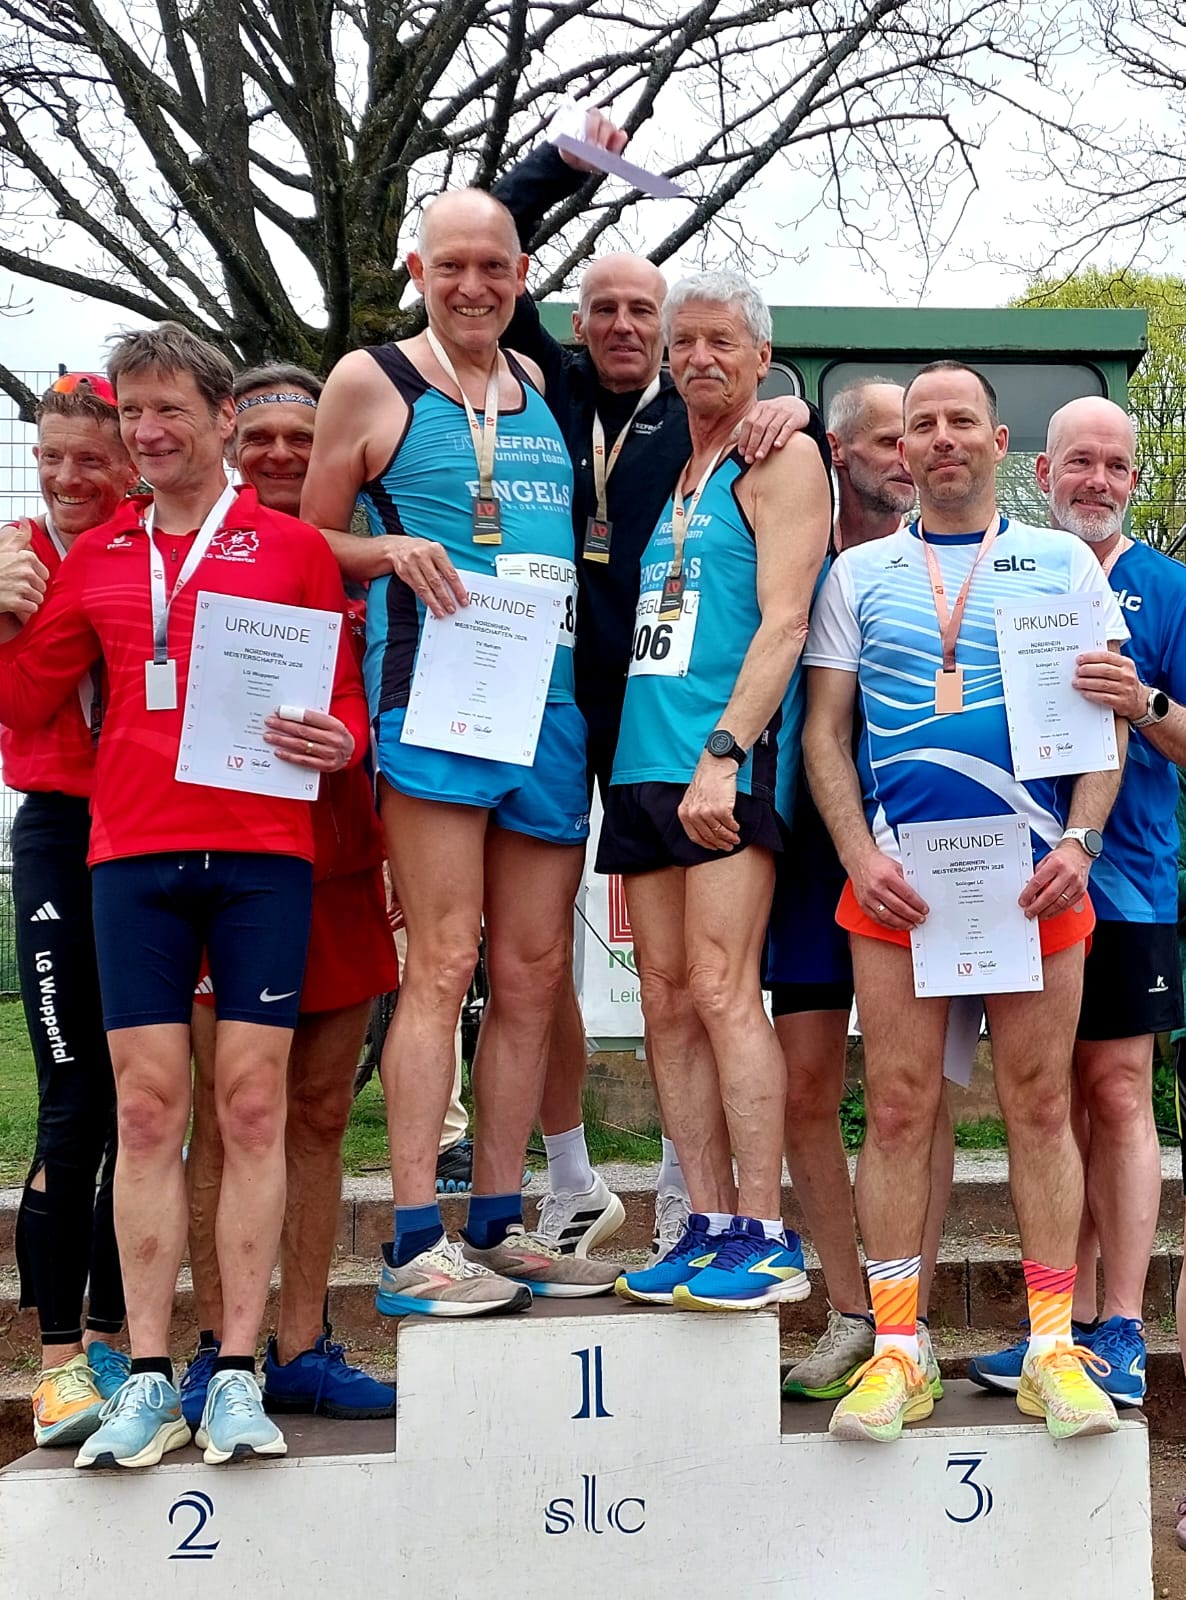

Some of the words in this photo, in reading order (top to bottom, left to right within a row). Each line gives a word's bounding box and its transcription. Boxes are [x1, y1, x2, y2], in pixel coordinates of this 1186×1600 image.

[495, 451, 540, 465] unning
[542, 452, 566, 465] team
[993, 555, 1037, 572] slc
[225, 616, 312, 643] URKUNDE
[1013, 612, 1080, 632] URKUNDE
[244, 647, 284, 659] NORDRHEIN
[631, 623, 673, 664] 06
[223, 650, 287, 666] MEISTERSCHAFTEN
[926, 833, 1006, 853] URKUNDE
[35, 950, 53, 973] LG
[39, 975, 75, 1064] Wuppertal
[571, 1345, 615, 1419] 1
[944, 1451, 993, 1523] 3
[544, 1474, 646, 1534] slc
[167, 1490, 221, 1559] 2
